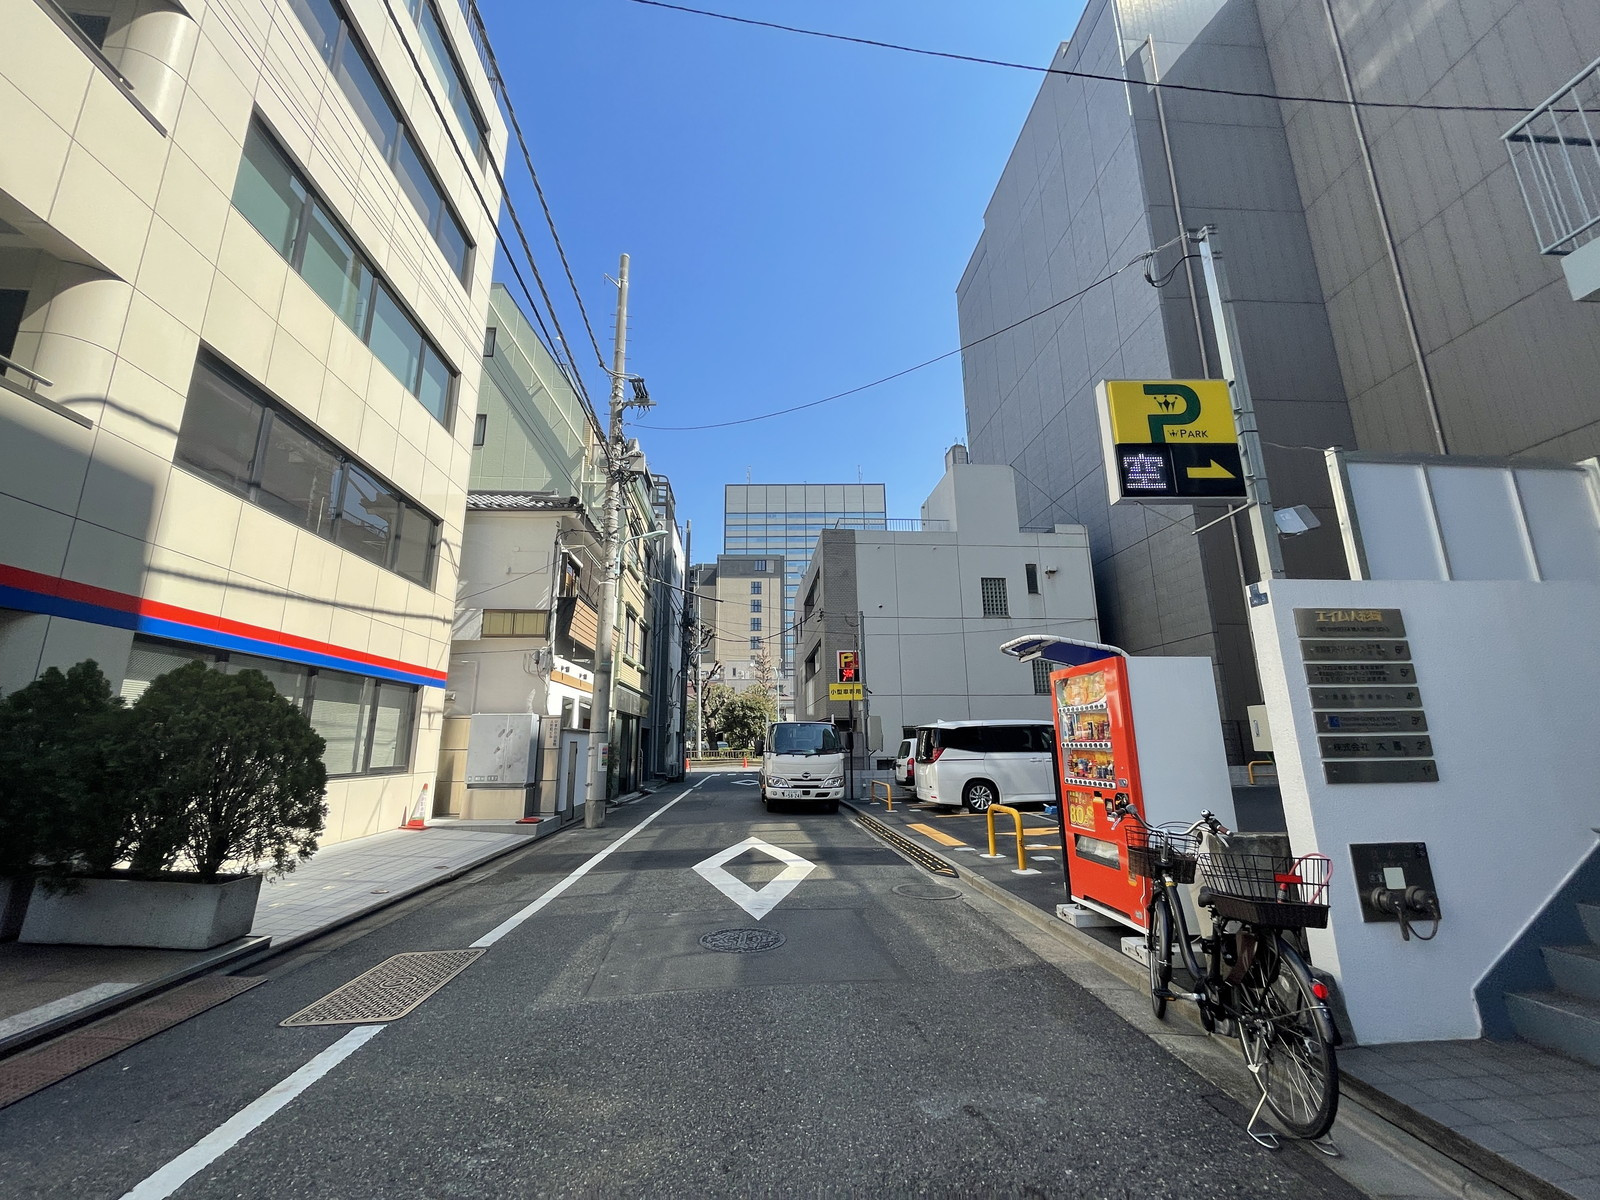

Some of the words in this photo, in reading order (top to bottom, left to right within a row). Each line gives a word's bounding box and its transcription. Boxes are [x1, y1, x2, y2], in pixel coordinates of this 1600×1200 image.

[1143, 384, 1201, 444] P
[1180, 429, 1208, 438] PARK
[1123, 453, 1167, 489] 空
[841, 653, 854, 667] P
